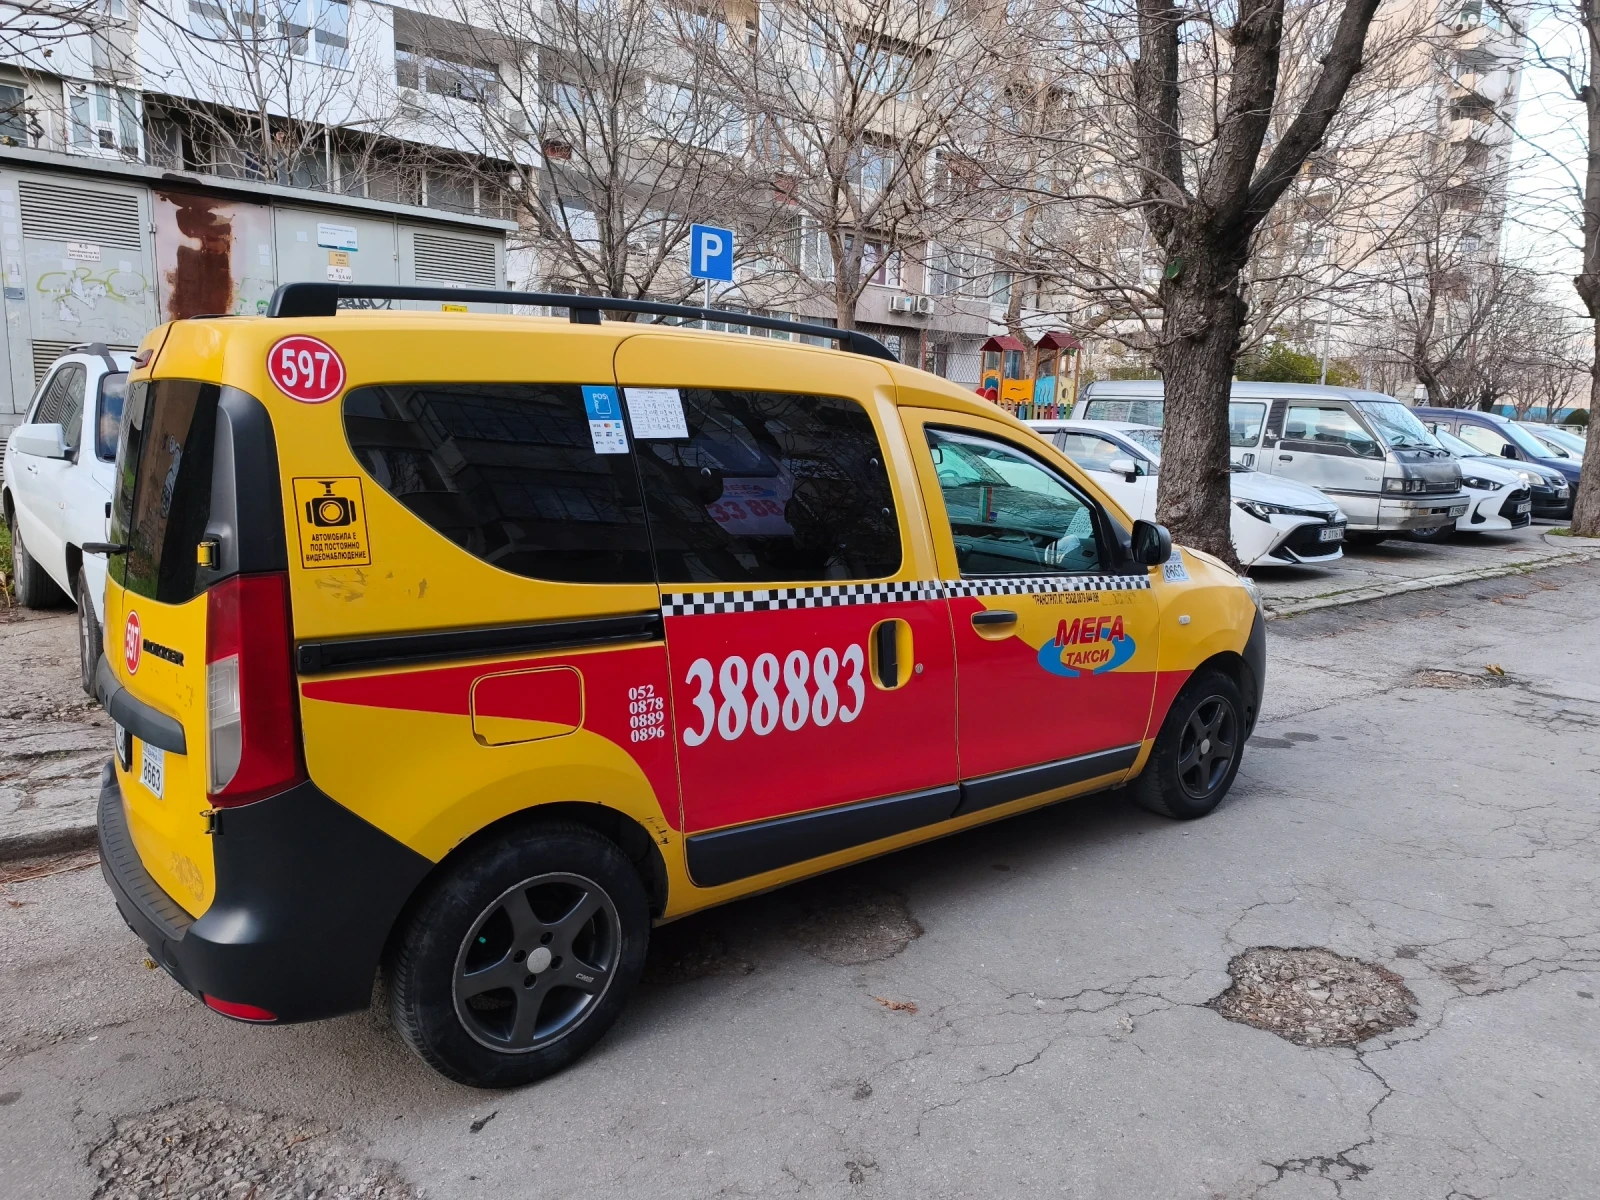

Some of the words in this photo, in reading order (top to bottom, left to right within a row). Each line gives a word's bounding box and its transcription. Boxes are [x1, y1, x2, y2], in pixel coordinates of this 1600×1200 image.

[700, 231, 723, 272] P
[281, 348, 331, 389] 597
[311, 532, 352, 541] АВТОМОБИЛА
[352, 532, 357, 540] Е
[305, 550, 367, 562] ВИДЕОНАБЛЮДЕНИЕ
[310, 543, 323, 552] ПОД
[324, 541, 360, 551] ПОСТОЯННО
[1164, 564, 1186, 579] 8663
[1053, 614, 1125, 647] МЕГА
[126, 622, 139, 662] 597
[142, 638, 185, 667] DOKKER
[1066, 648, 1110, 666] ТАКСИ
[628, 684, 655, 700] 052
[682, 643, 866, 747] 388883
[629, 696, 664, 714] 0878
[630, 710, 665, 729] 0889
[631, 724, 665, 743] 0896
[143, 758, 161, 791] 8663
